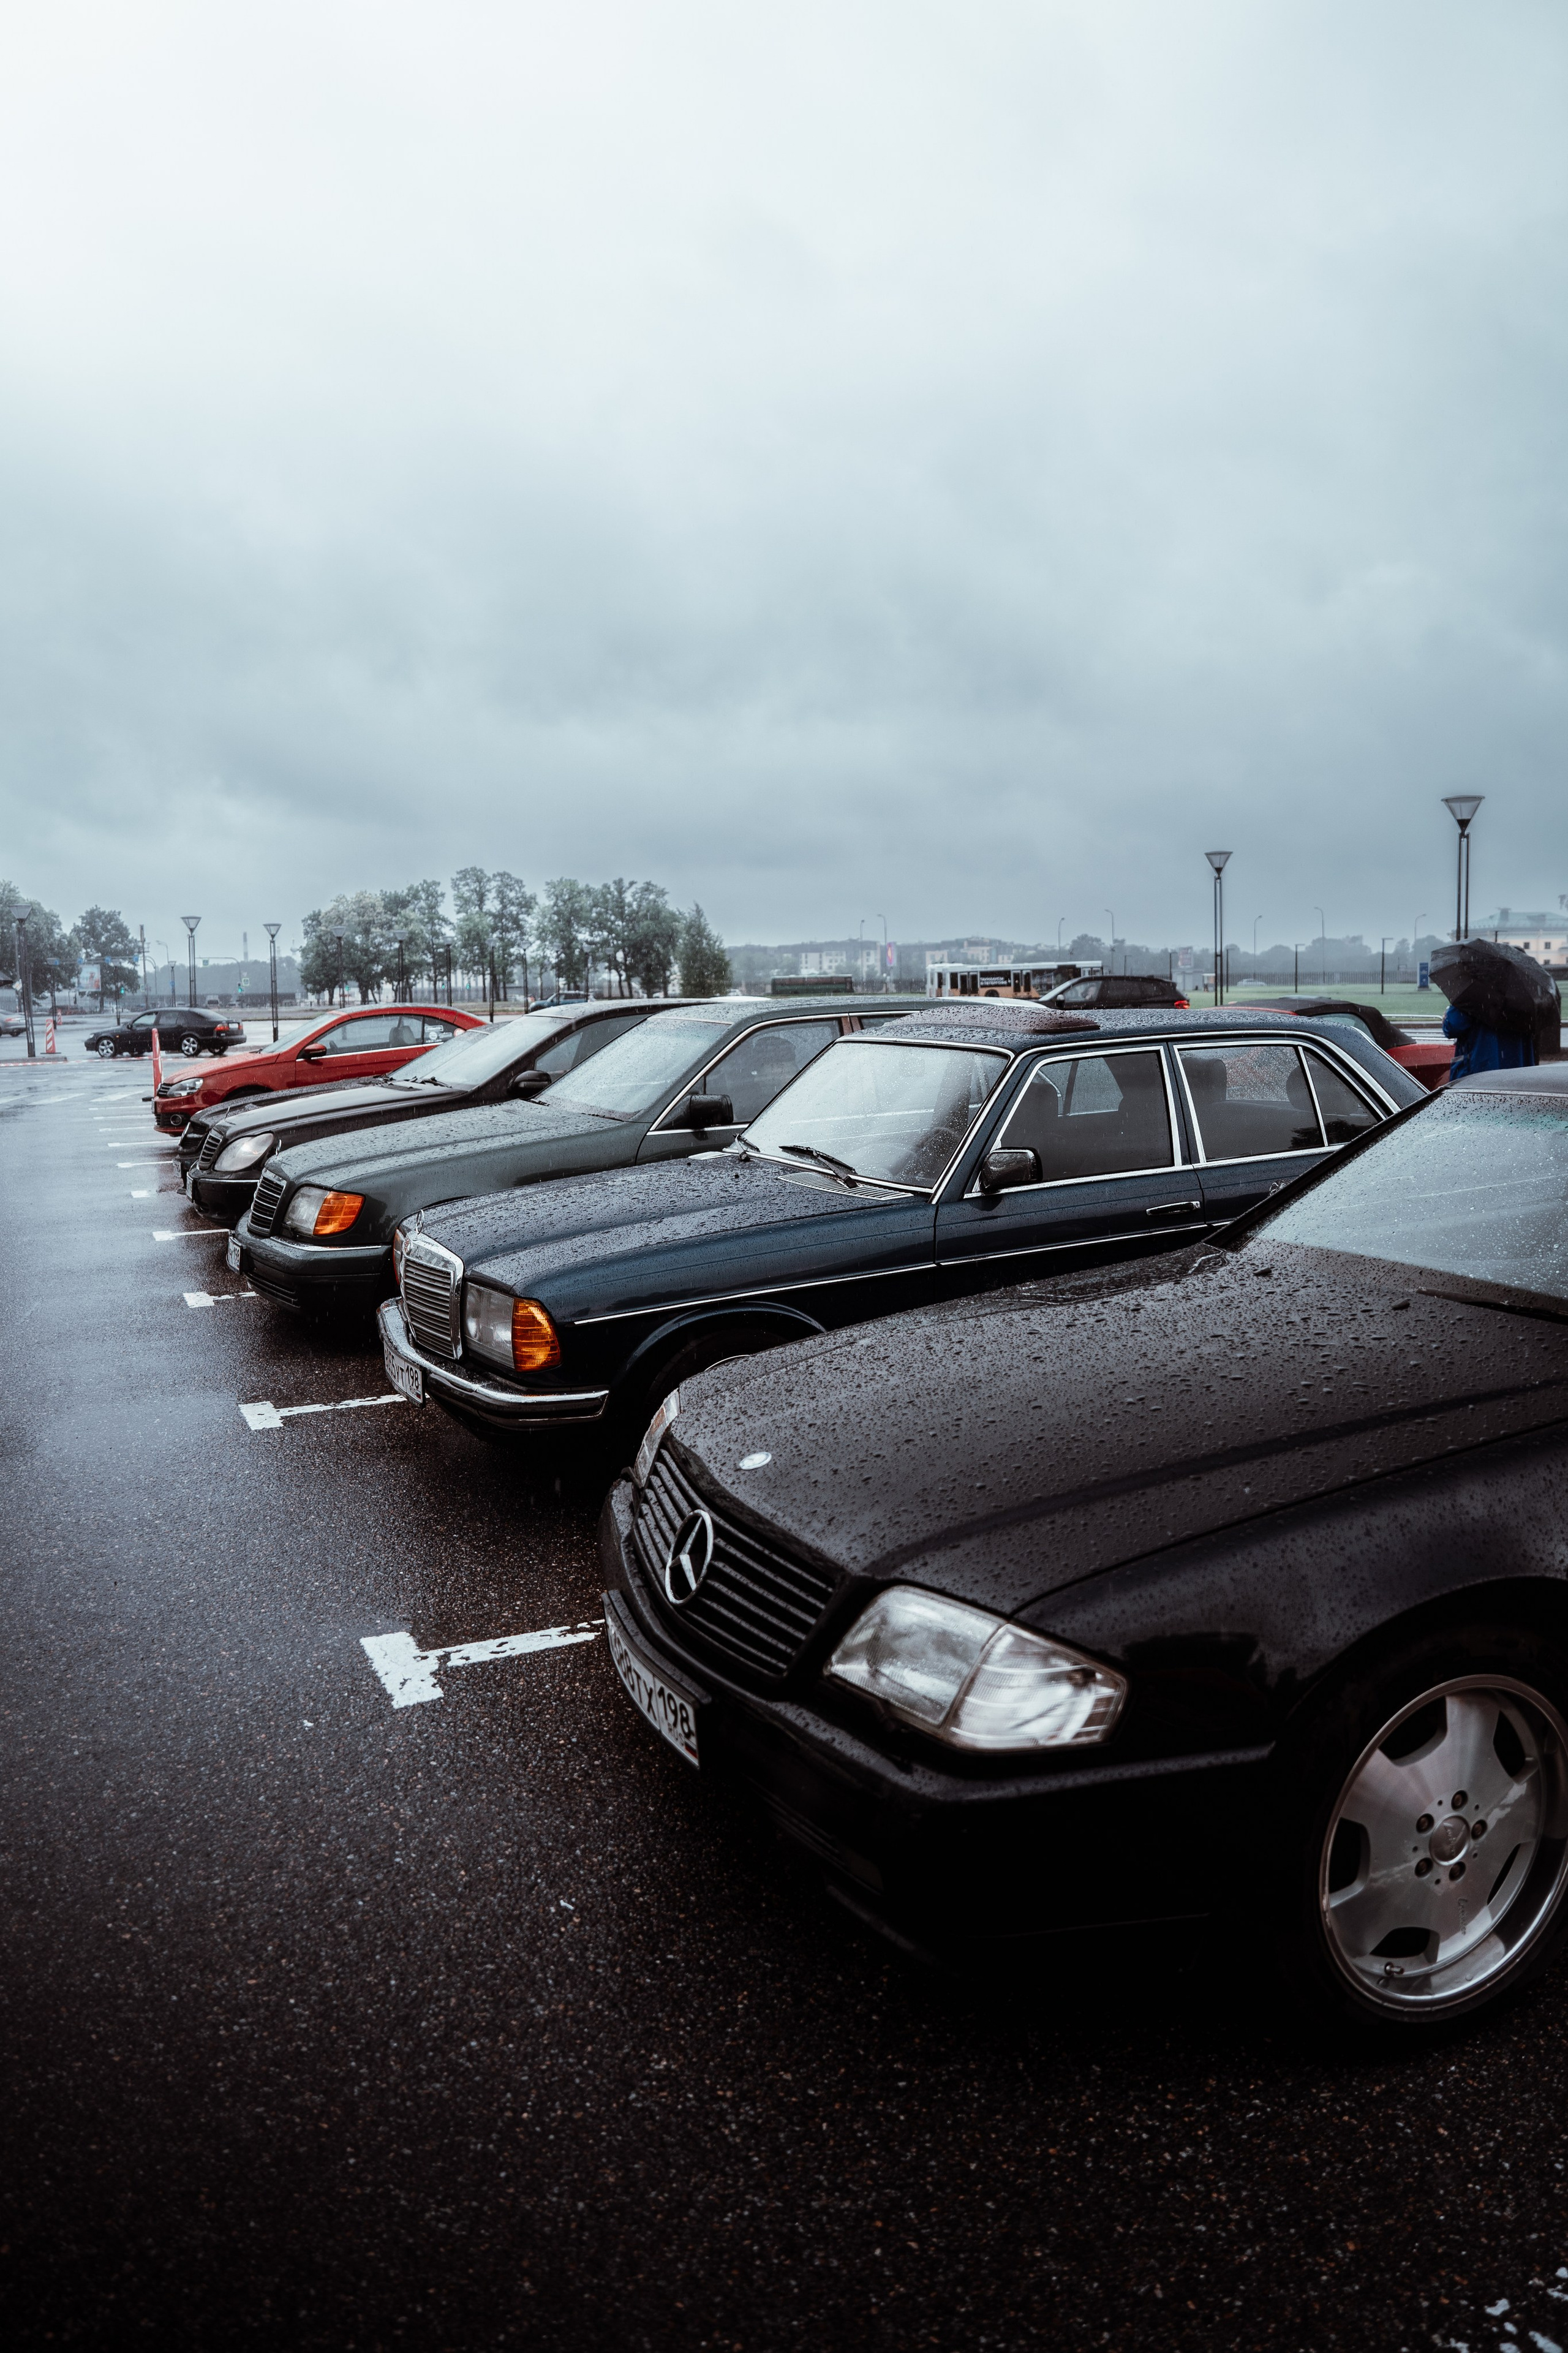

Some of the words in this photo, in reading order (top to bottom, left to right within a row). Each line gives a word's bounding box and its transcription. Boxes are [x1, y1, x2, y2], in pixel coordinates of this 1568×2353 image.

[406, 1365, 419, 1389] 198
[657, 1685, 694, 1740] 198
[668, 1723, 685, 1746] RUS
